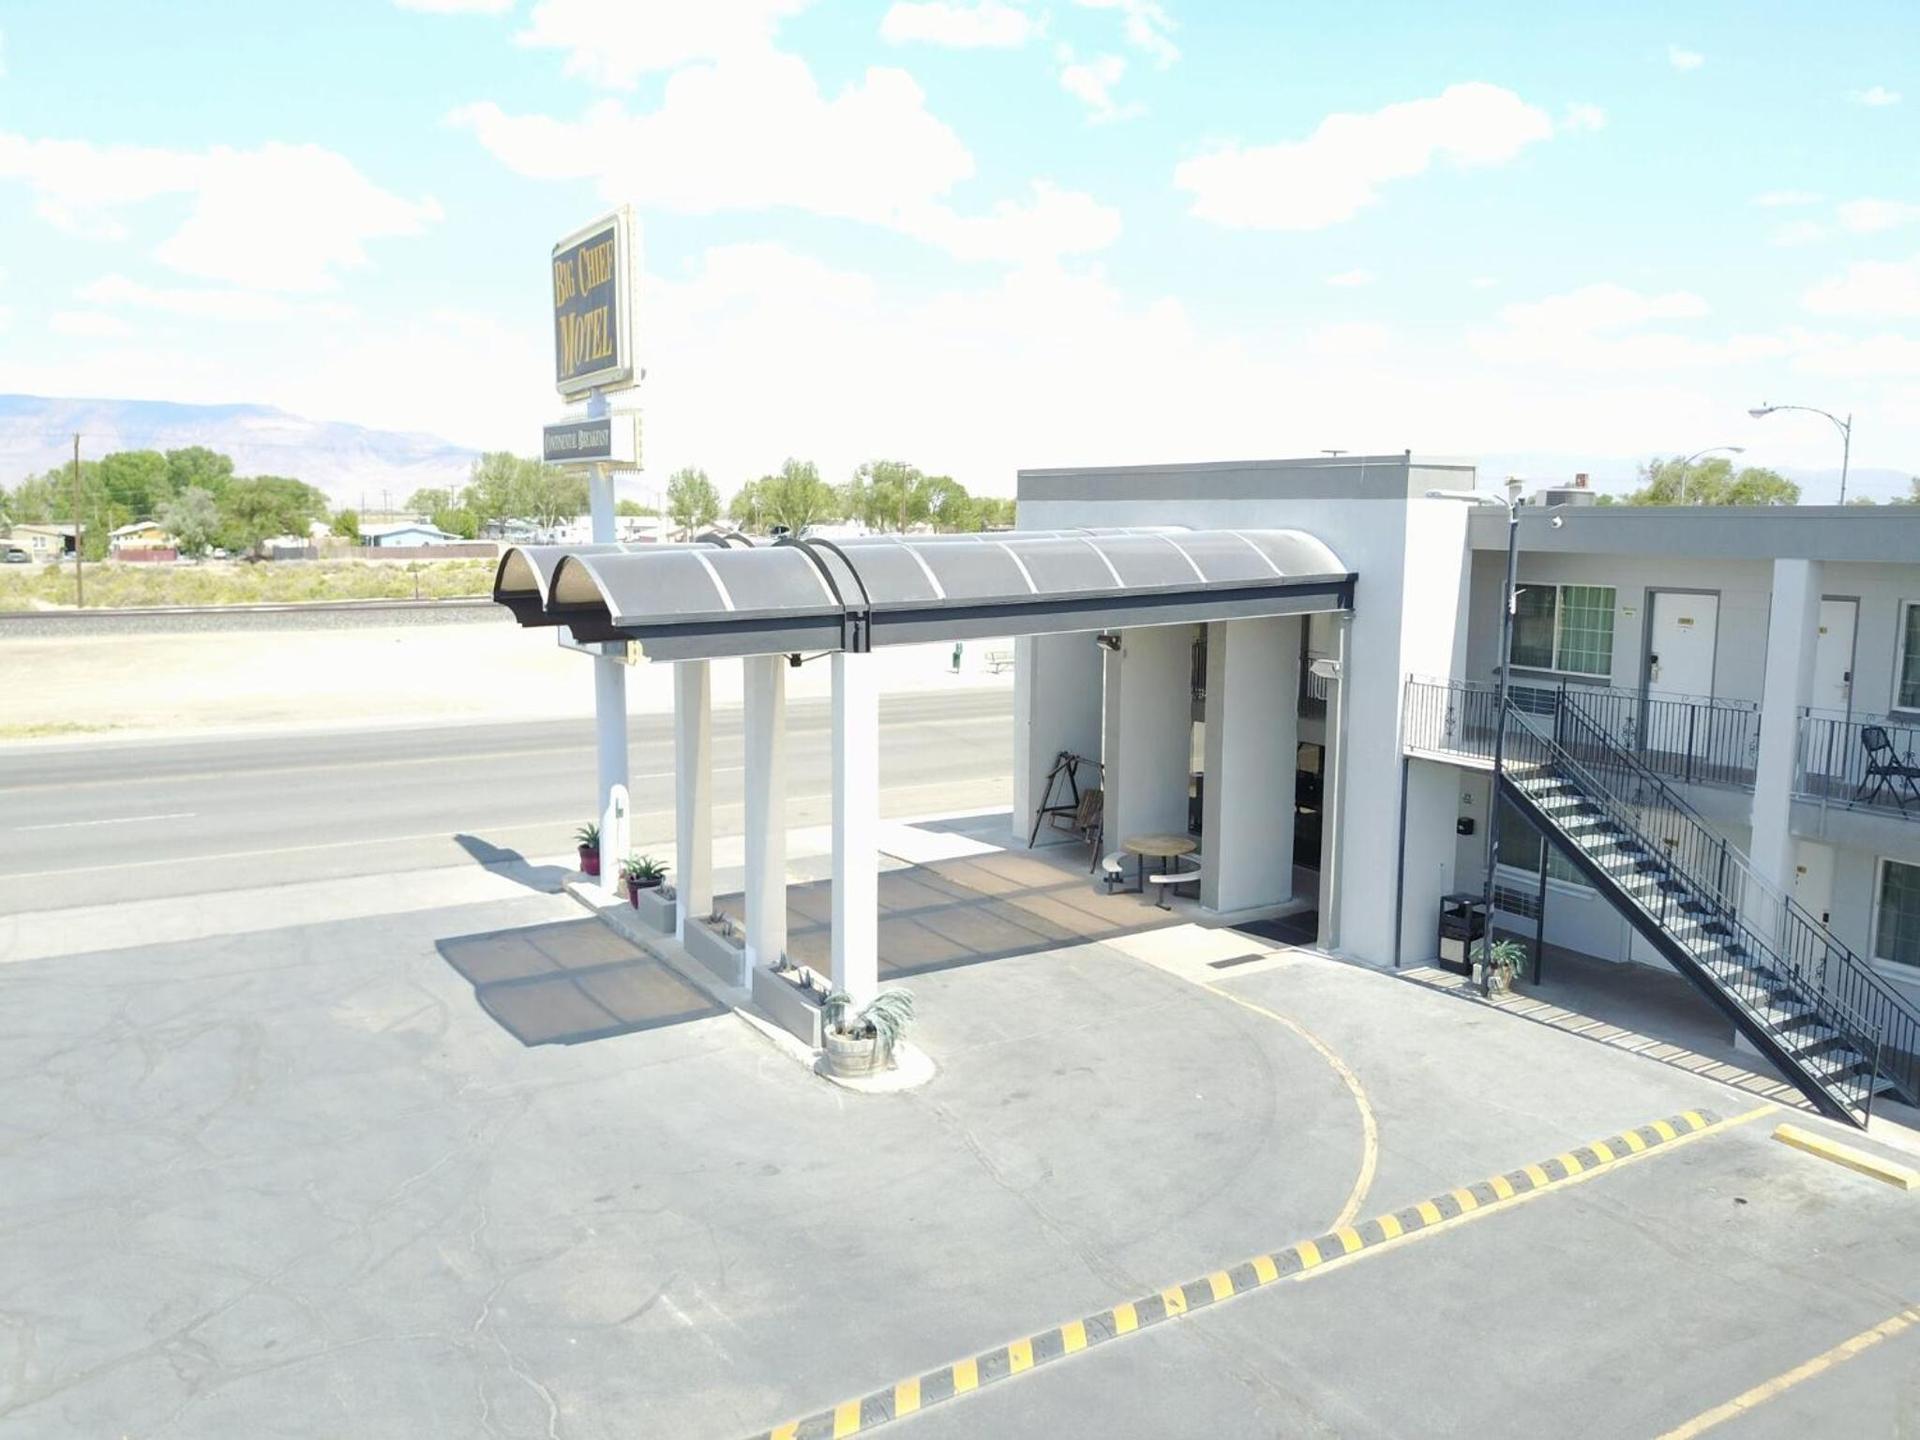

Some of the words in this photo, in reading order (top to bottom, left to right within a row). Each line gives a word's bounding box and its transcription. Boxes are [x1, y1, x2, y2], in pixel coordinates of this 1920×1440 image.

[554, 260, 576, 308] BIG
[578, 240, 614, 297] CHIEF
[559, 305, 613, 378] MOTEL
